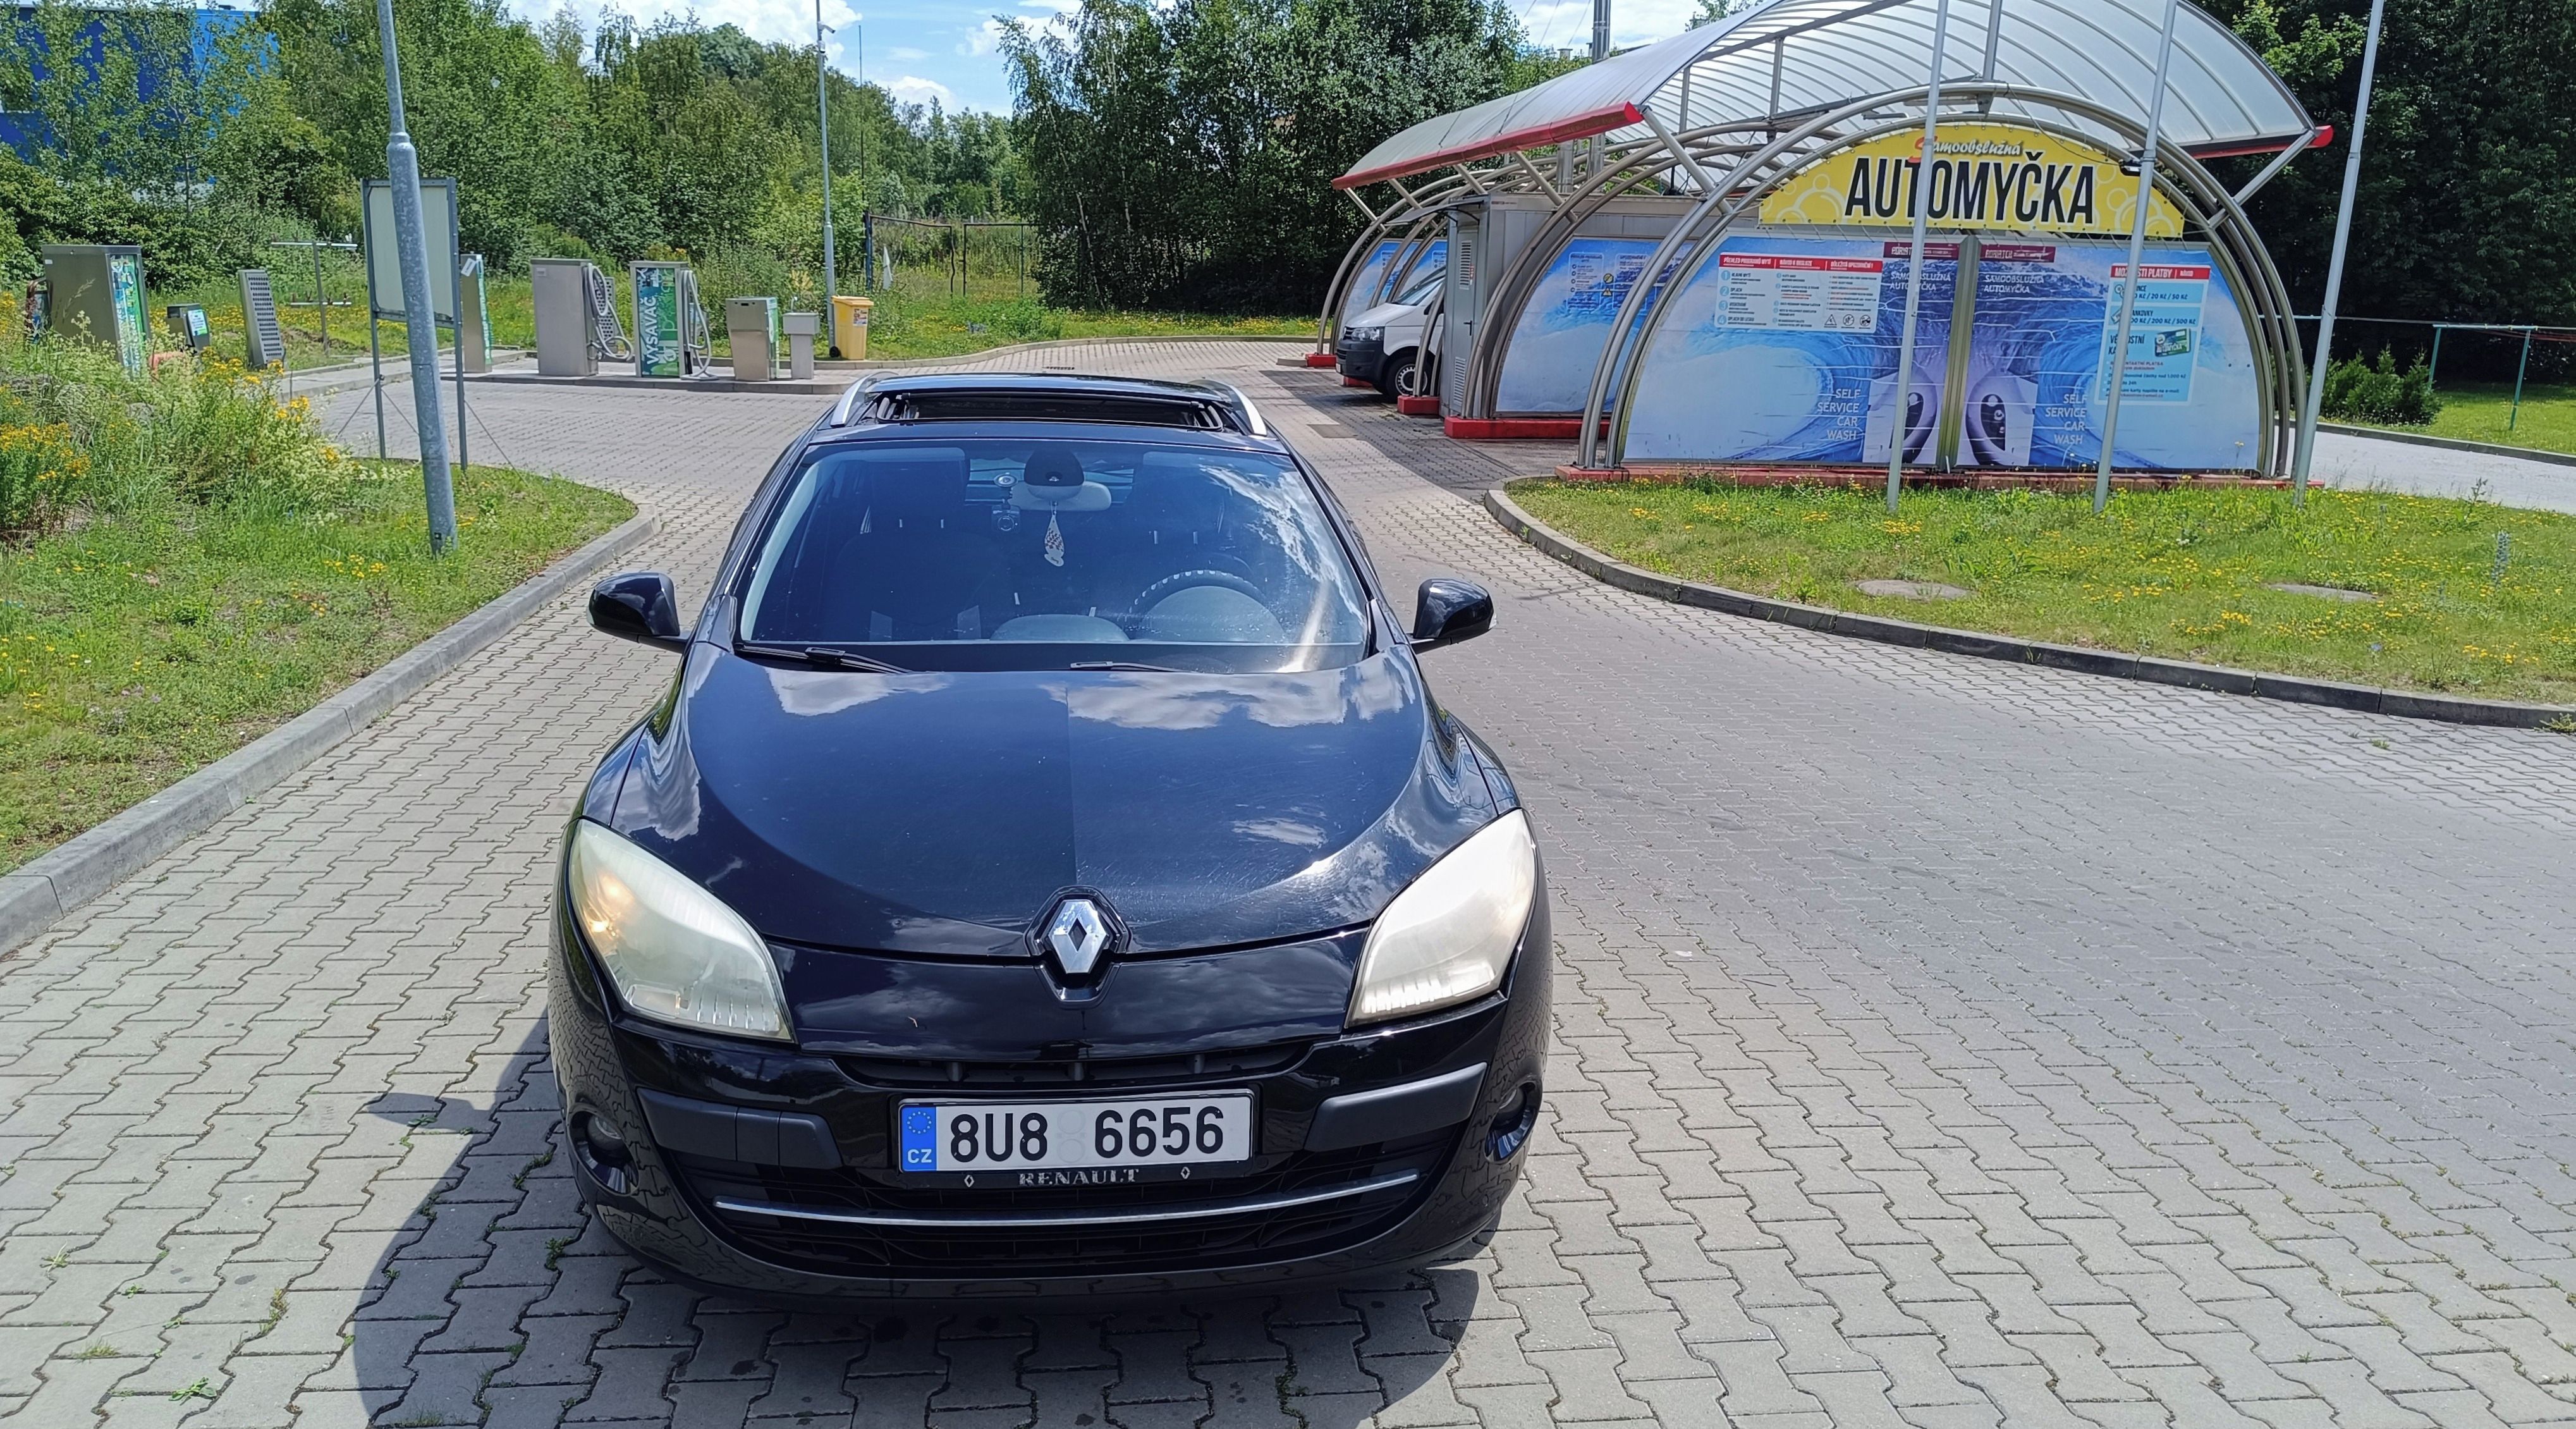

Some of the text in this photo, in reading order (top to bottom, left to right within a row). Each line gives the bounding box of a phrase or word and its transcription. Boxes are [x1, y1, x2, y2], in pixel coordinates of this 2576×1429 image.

[1845, 152, 2094, 223] AUTOMYČKA
[2115, 267, 2147, 278] MOŽSTI
[2149, 267, 2173, 278] PLATBY
[640, 297, 659, 365] VYSAVAČ
[1836, 388, 1860, 398] SELF
[2063, 394, 2088, 403] SELF
[1817, 402, 1859, 412] SERVICE
[2045, 407, 2086, 417] SERVICE
[1837, 417, 1857, 426] CAR
[2064, 421, 2085, 431] CAR
[1827, 430, 1857, 440] WASH
[2054, 434, 2083, 444] WASH
[907, 1106, 1224, 1164] CZ 8U8 6656
[1018, 1169, 1139, 1186] RENAULT
